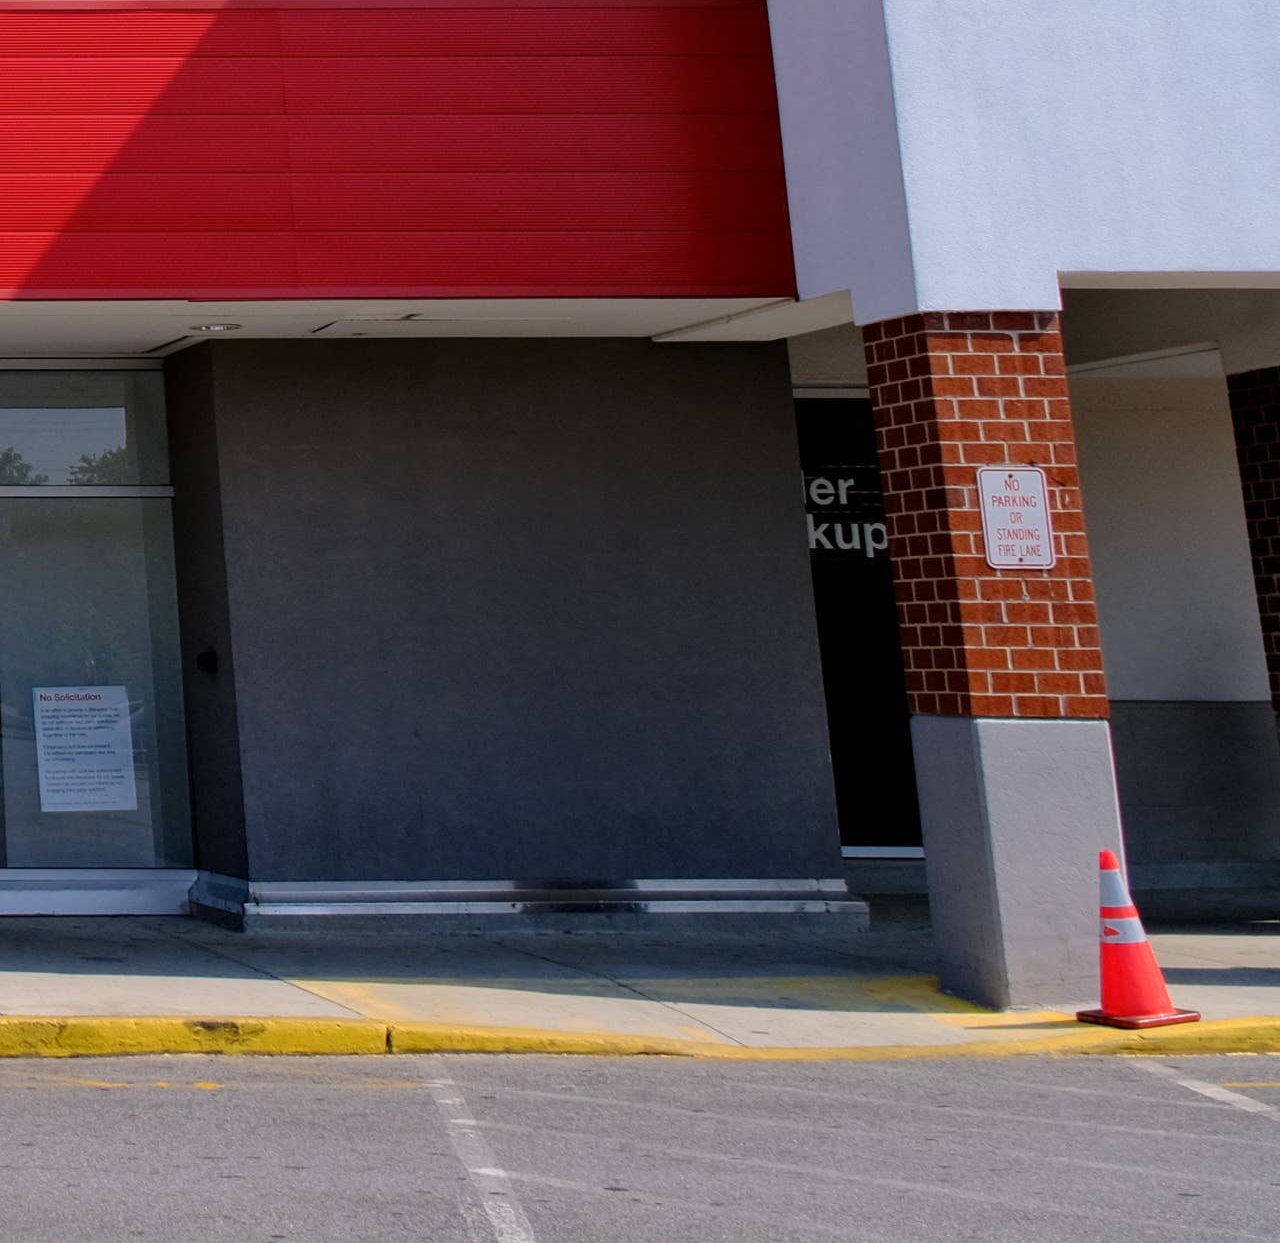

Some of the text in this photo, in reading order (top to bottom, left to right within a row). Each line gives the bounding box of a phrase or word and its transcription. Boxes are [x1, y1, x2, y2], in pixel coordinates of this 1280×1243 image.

[800, 469, 855, 506] er
[1004, 479, 1020, 491] NO
[991, 495, 1037, 508] PARKING
[1009, 512, 1023, 524] OR
[806, 513, 889, 558] kup
[996, 528, 1041, 541] STANDING
[998, 544, 1042, 557] FIRE LANE
[39, 692, 102, 702] No Solicitation
